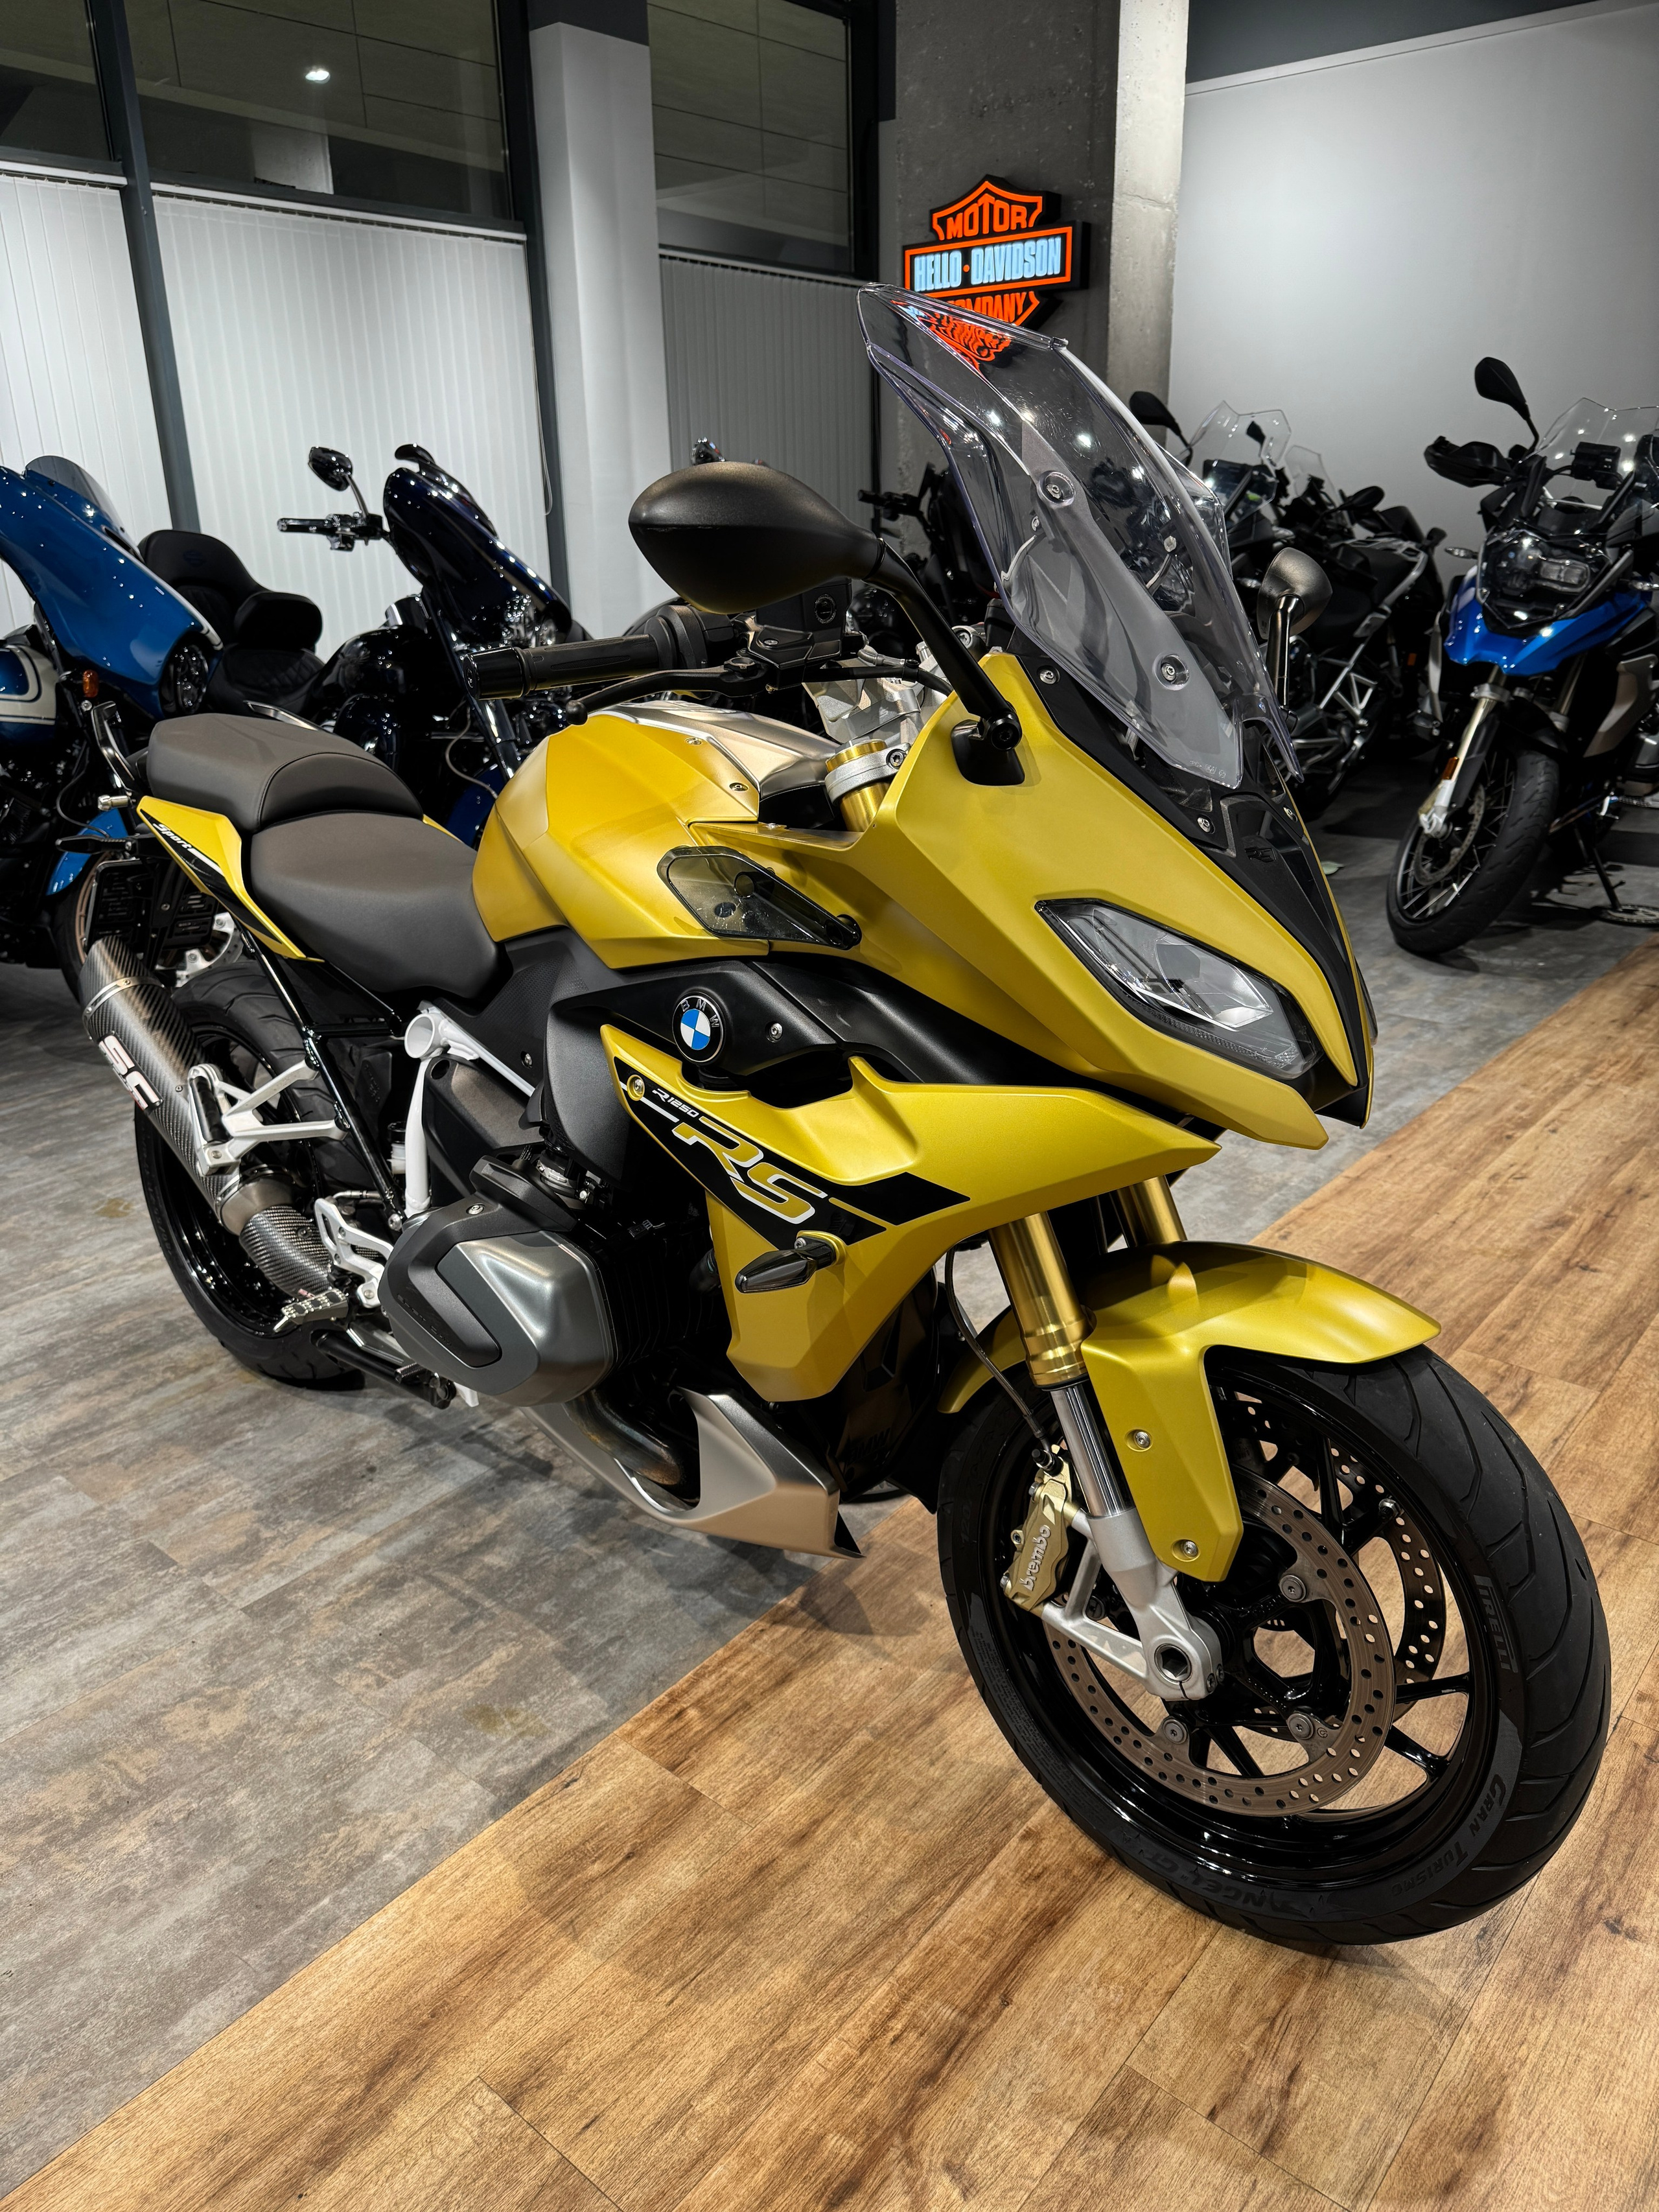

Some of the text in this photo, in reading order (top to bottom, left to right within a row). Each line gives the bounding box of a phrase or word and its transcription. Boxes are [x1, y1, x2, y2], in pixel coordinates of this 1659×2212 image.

[946, 193, 1027, 240] MOTOR
[914, 236, 1062, 292] HELLO DAVIDSON
[152, 822, 192, 849] Sport
[680, 998, 720, 1029] BMW
[99, 1034, 160, 1110] SC
[671, 1115, 829, 1225] RS
[1018, 1524, 1052, 1592] brembo
[1473, 1574, 1518, 1673] PIRELLI
